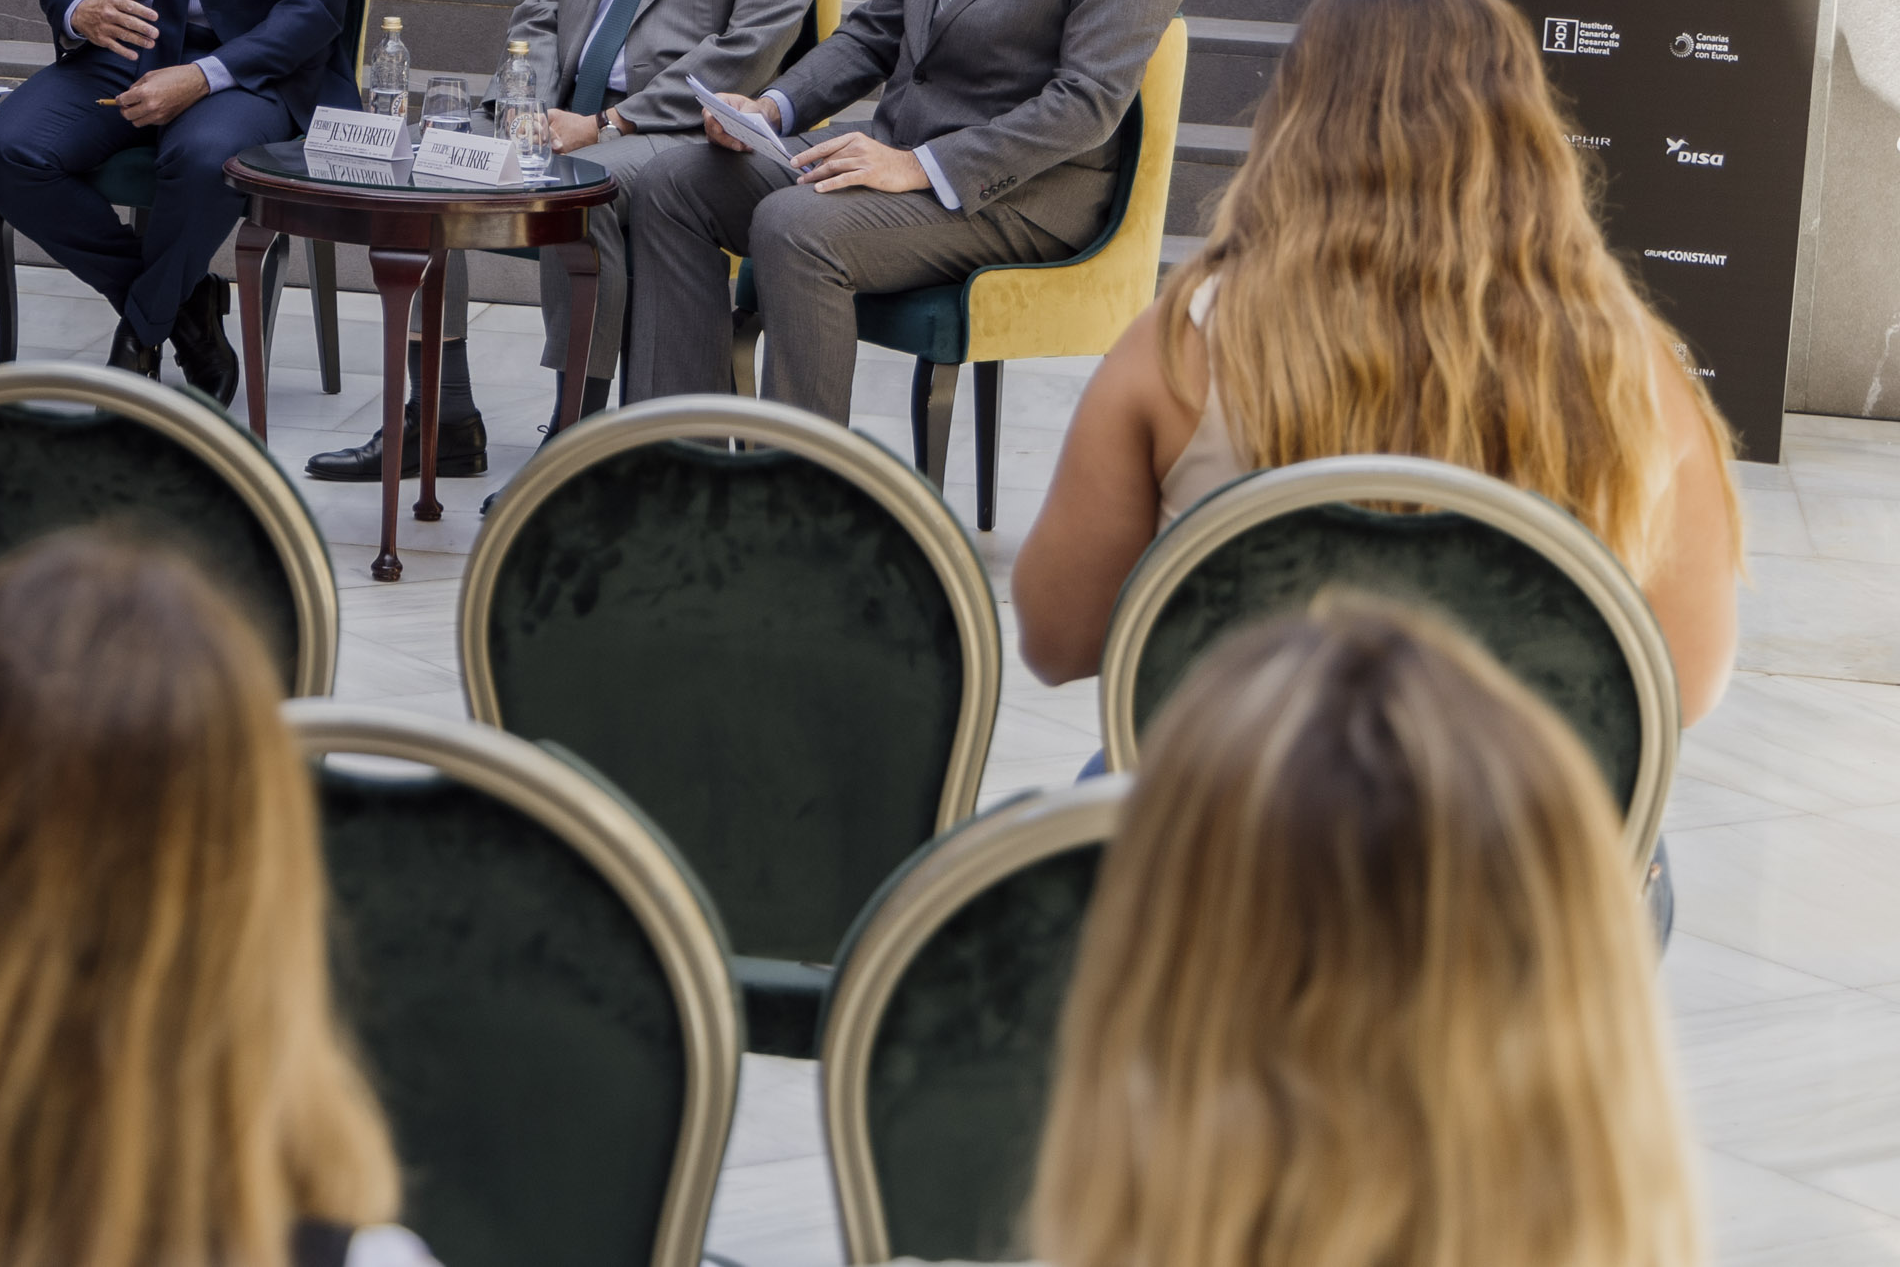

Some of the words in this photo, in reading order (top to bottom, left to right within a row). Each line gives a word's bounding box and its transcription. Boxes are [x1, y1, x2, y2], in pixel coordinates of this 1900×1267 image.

[1580, 22, 1613, 31] Instituto
[1554, 22, 1568, 49] ICDC
[1579, 29, 1608, 38] Canario
[1696, 33, 1729, 43] Canarias
[1579, 38, 1619, 48] Desarrollo
[1696, 43, 1729, 52] avanza
[1578, 46, 1610, 55] Cultural
[1711, 52, 1738, 62] Europa
[313, 119, 332, 131] PEDRO
[327, 122, 362, 144] JUSTO
[361, 126, 396, 147] BRITO
[431, 143, 450, 154] FELIPE
[446, 146, 494, 171] AGUIRRE
